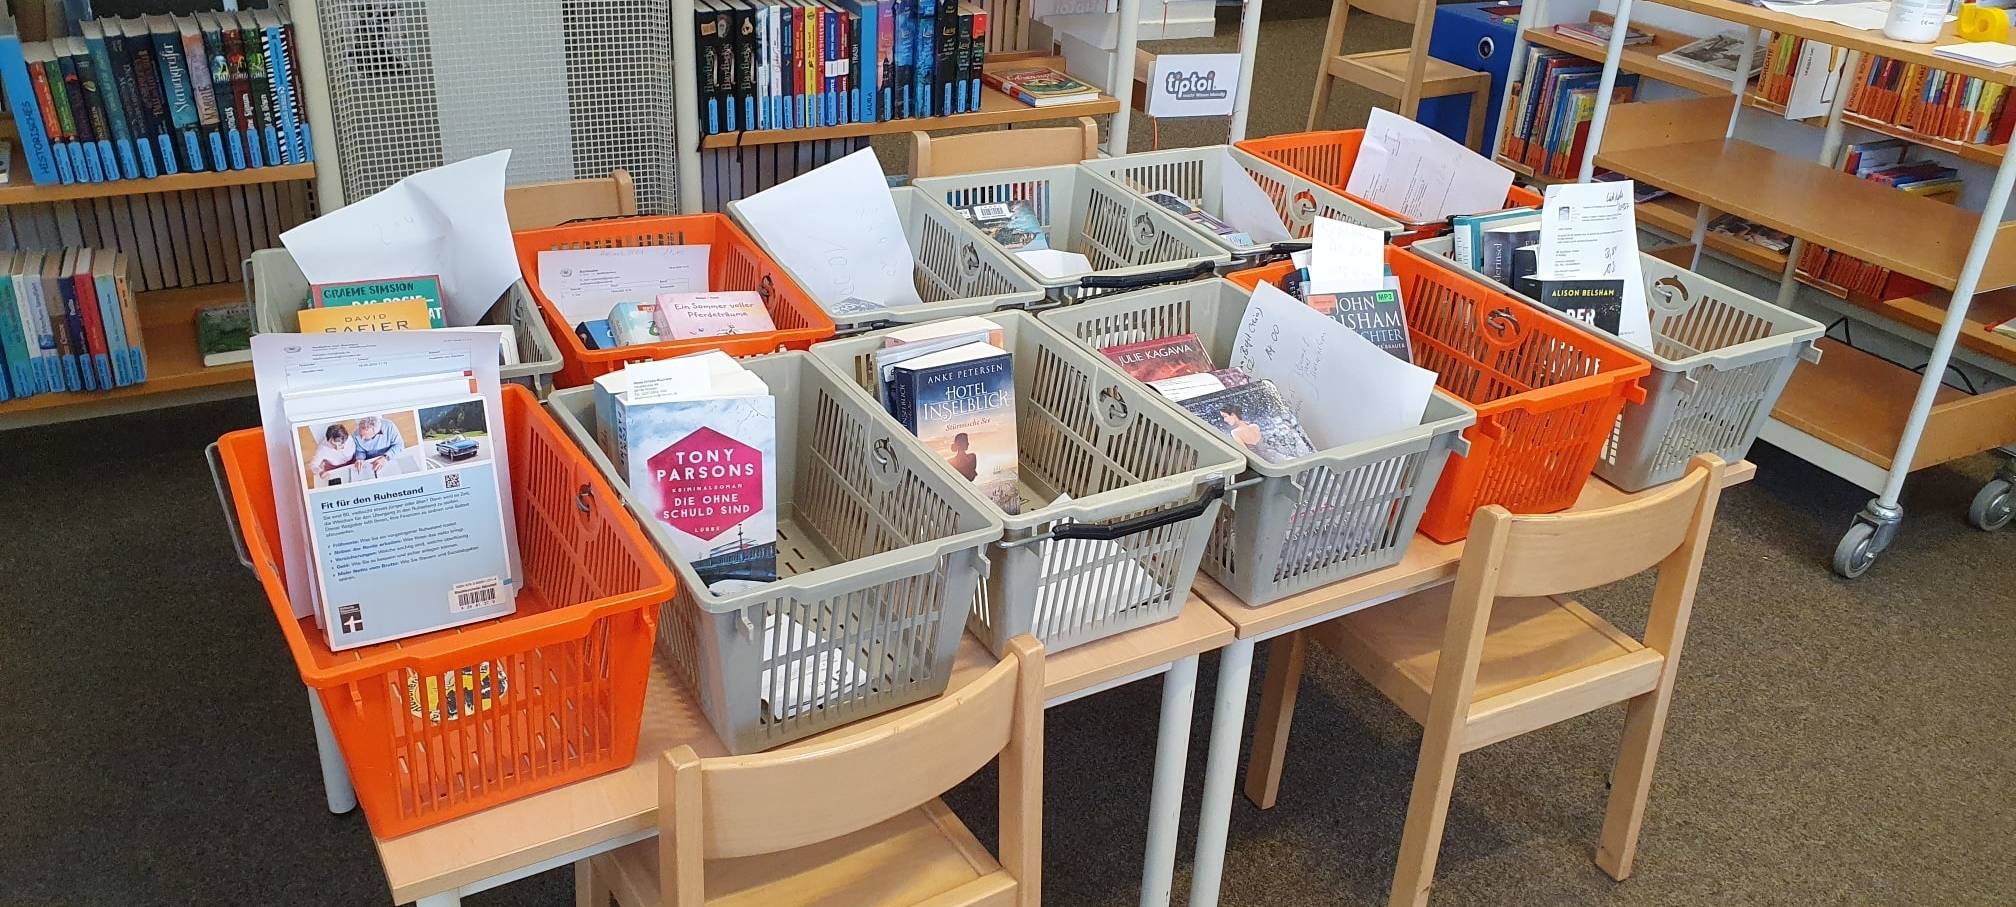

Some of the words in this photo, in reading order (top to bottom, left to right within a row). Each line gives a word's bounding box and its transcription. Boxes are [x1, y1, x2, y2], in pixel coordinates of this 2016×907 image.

[1167, 70, 1216, 98] tiptoi
[23, 100, 50, 174] HISTORISCHES
[324, 286, 366, 299] GRAEME
[369, 282, 415, 295] SIMSION
[1377, 292, 1393, 301] MP3
[1551, 289, 1580, 297] ALISON
[1581, 288, 1616, 297] BELSHAM
[674, 303, 691, 311] Ein
[691, 302, 728, 310] Sommer
[728, 301, 755, 309] voller
[1335, 295, 1376, 314] JOHN
[344, 313, 387, 322] DAVID
[687, 310, 749, 319] Pferdeträume
[1330, 310, 1401, 330] ISHAM
[325, 320, 410, 334] SAFIER
[1118, 352, 1145, 367] JULIE
[1145, 344, 1194, 360] KAGAWA
[927, 373, 954, 384] ANKE
[957, 363, 1004, 380] PETERSEN
[944, 382, 989, 400] HOTEL
[922, 390, 1012, 421] INSELBLICK
[674, 448, 735, 466] TONY
[656, 463, 756, 483] PARSONS
[671, 483, 744, 493] KRIMINALROMAN
[321, 502, 333, 510] Fit
[336, 498, 351, 508] für
[353, 495, 371, 505] den
[374, 486, 425, 502] Ruhestand
[674, 496, 696, 507] DIE
[702, 493, 739, 504] OHNE
[663, 507, 715, 520] SCHULD
[720, 504, 751, 515] SIND
